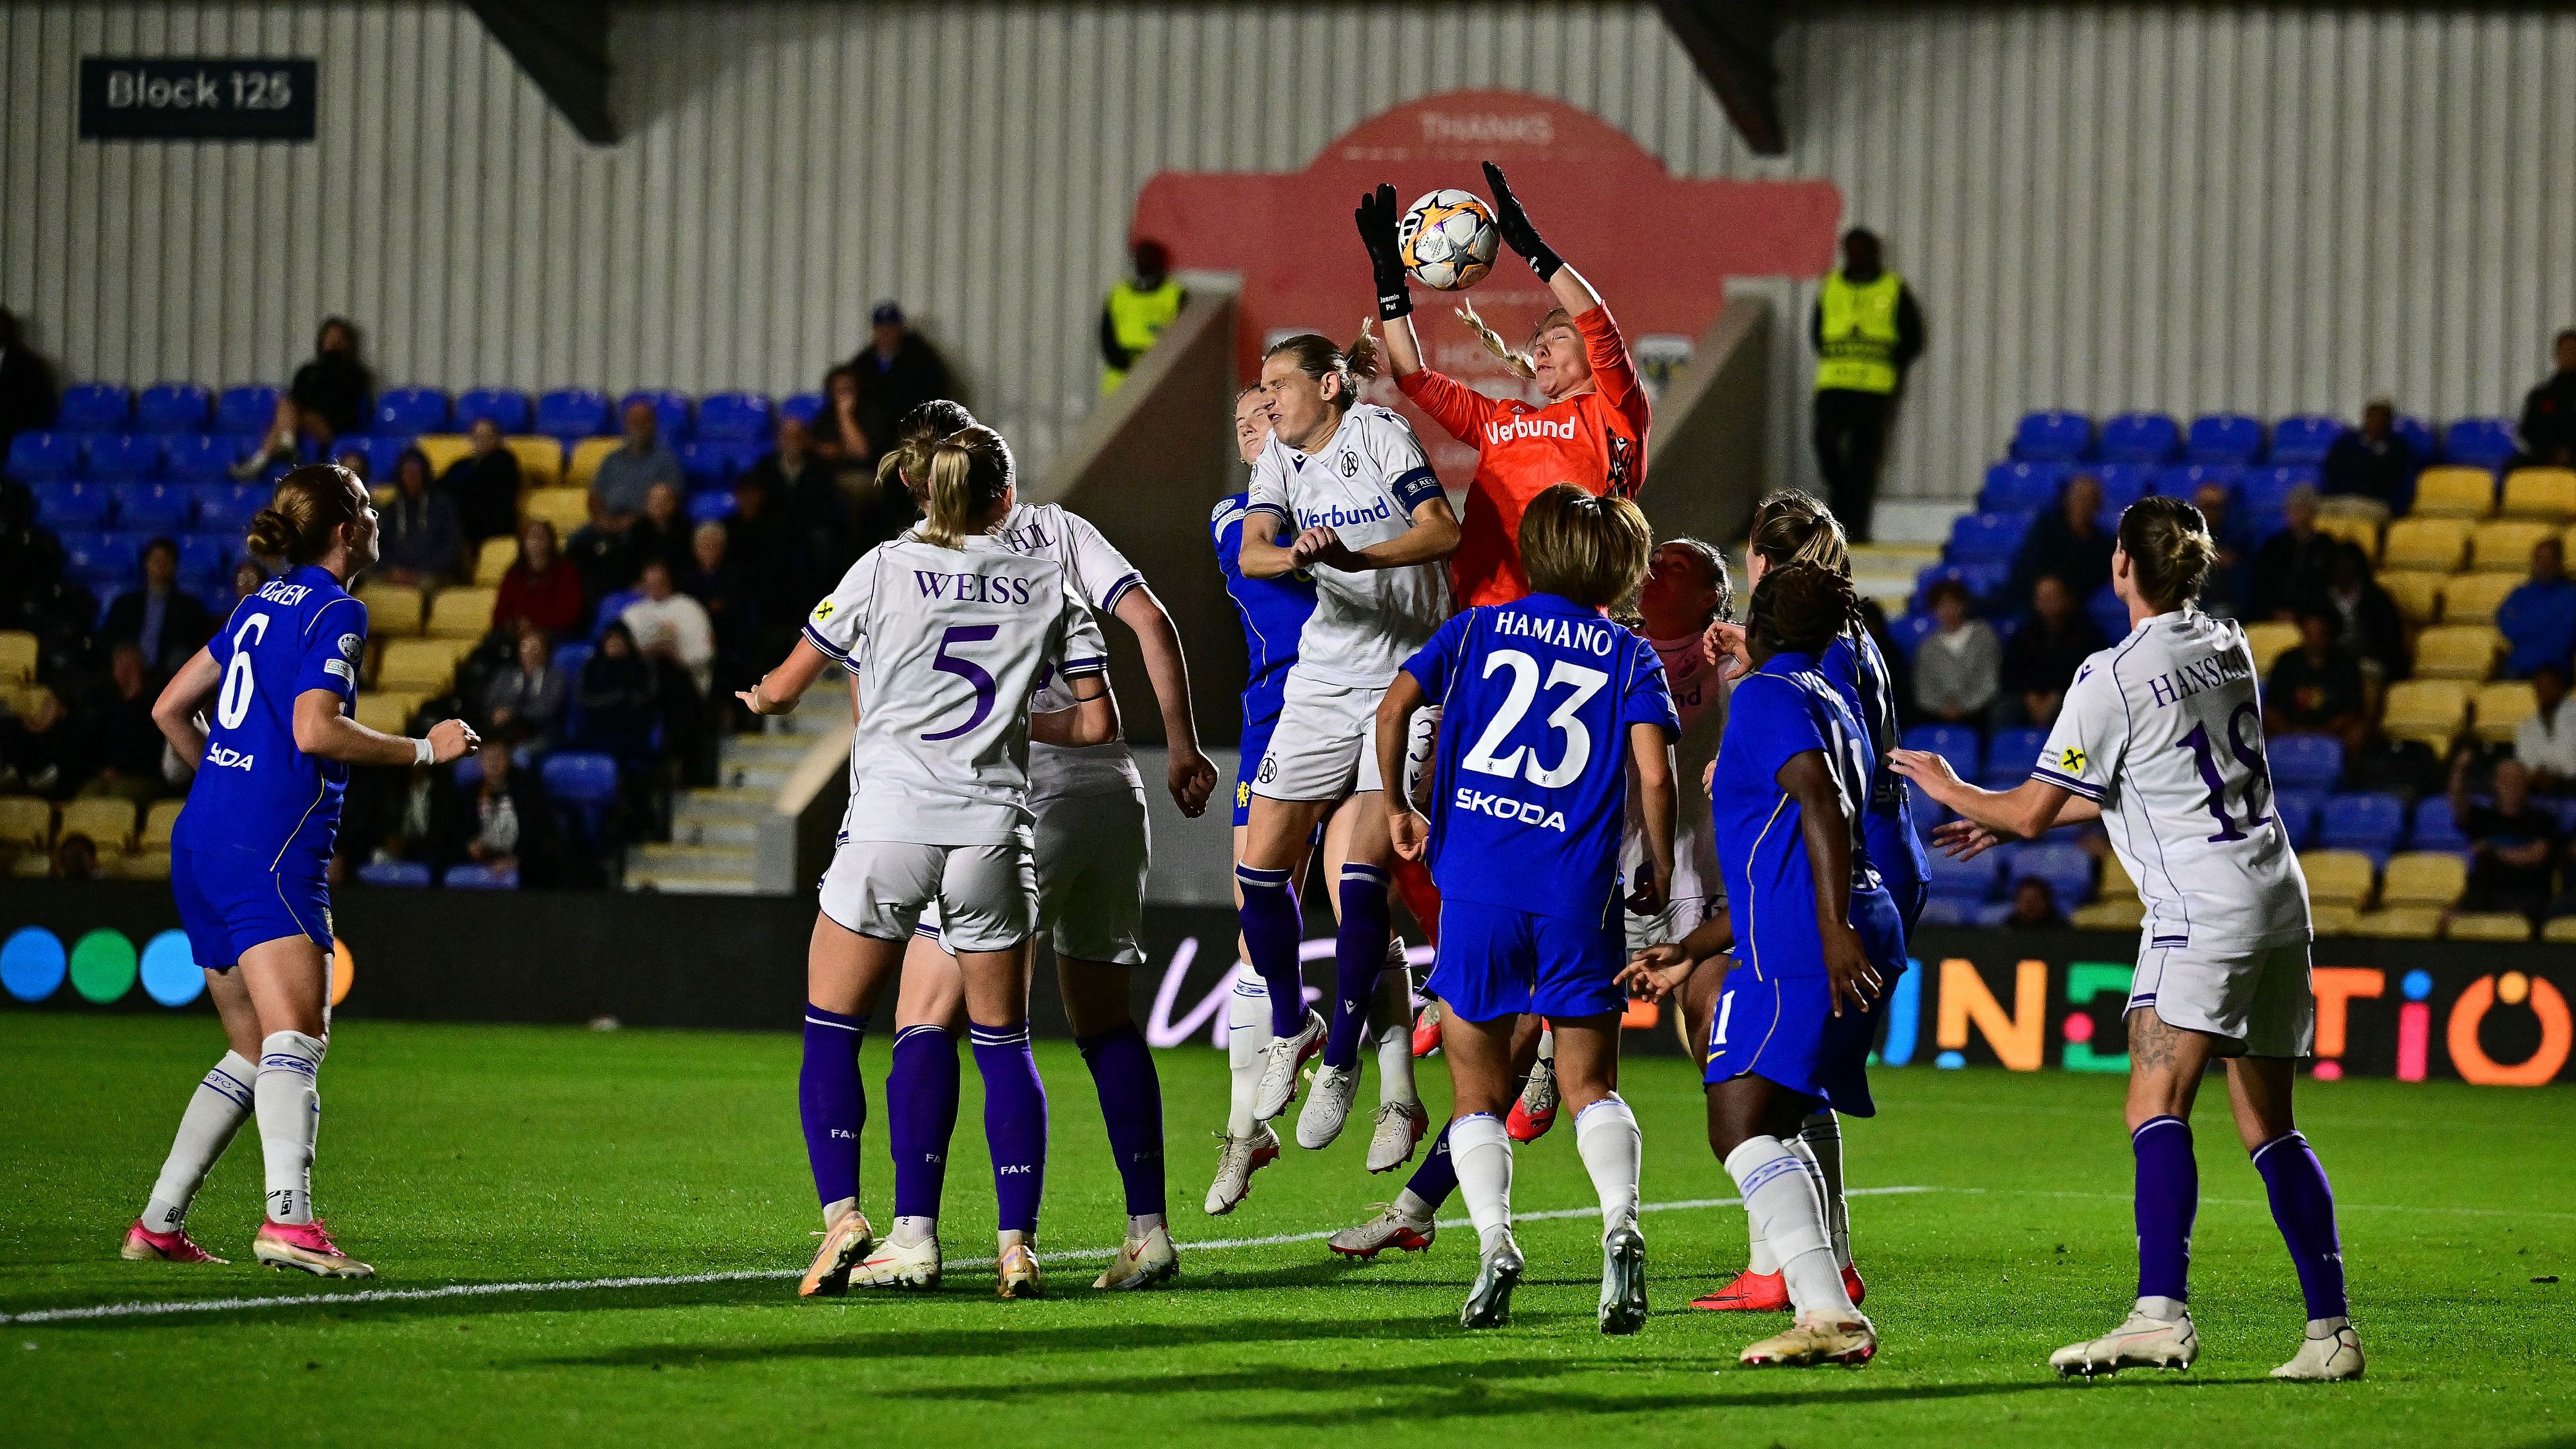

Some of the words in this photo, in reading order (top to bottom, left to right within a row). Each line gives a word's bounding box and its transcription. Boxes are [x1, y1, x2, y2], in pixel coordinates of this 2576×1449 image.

[108, 71, 220, 108] Block
[231, 71, 292, 108] 125
[1420, 112, 1553, 145] THANKS
[1380, 294, 1400, 303] Jasmin
[1385, 303, 1396, 311] Pal
[1485, 414, 1576, 445] Verbund
[1297, 495, 1391, 531] Verbund
[913, 570, 1030, 605] WEISS
[1494, 612, 1612, 656] HAMANO
[218, 613, 270, 730] 6
[920, 624, 1000, 740] 5
[1461, 648, 1609, 788] 23
[2176, 701, 2272, 843] 18
[1000, 1165, 1031, 1175] FAK
